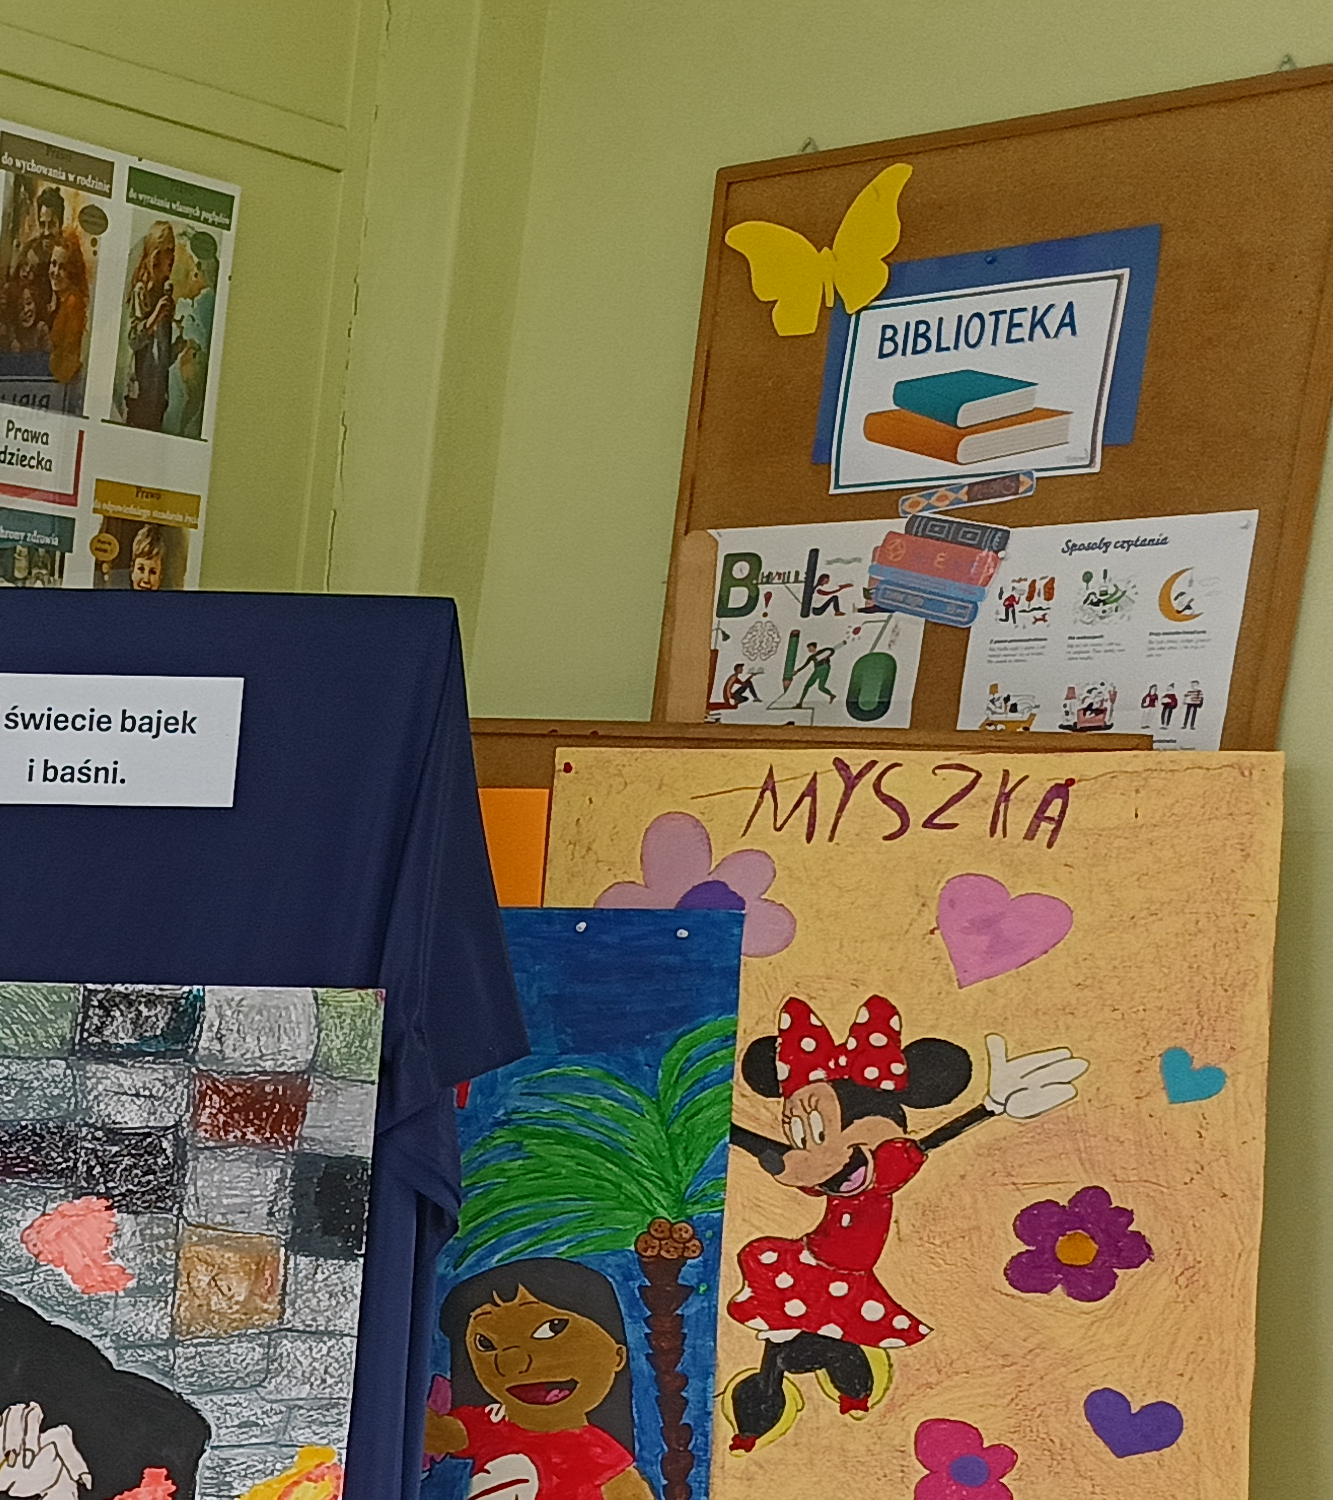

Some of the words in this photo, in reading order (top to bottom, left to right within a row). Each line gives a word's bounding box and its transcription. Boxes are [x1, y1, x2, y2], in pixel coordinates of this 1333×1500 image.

[1, 151, 13, 166] do
[15, 159, 66, 180] wychowania
[67, 172, 75, 182] w
[76, 174, 111, 193] rodzinie
[878, 300, 1078, 360] BIBLIOTEKA
[5, 419, 50, 446] Prawa
[27, 530, 59, 546] zdrowia
[1061, 536, 1112, 556] Sposoby
[1113, 533, 1169, 552] czytania
[4, 704, 113, 732] świecie
[120, 708, 198, 739] bajek
[27, 758, 35, 783] i
[42, 758, 127, 785] baśni.
[740, 756, 1075, 849] MYSZKA
